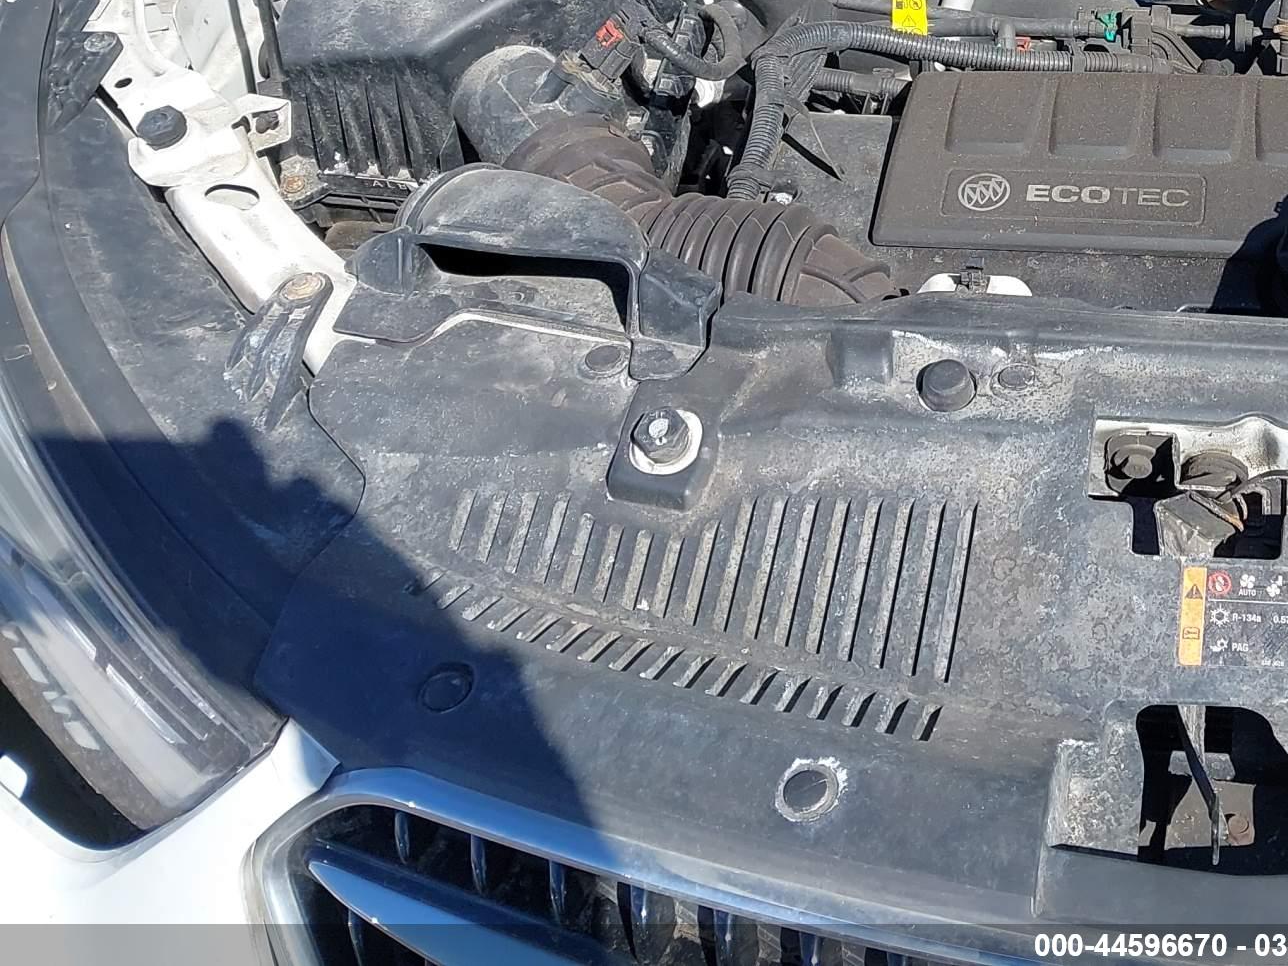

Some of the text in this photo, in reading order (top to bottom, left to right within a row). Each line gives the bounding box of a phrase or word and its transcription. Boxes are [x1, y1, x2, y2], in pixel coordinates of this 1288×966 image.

[1026, 184, 1190, 207] ECOTEC
[1238, 588, 1257, 597] AUTO
[1232, 613, 1262, 623] R-134a
[1231, 642, 1249, 652] PAG
